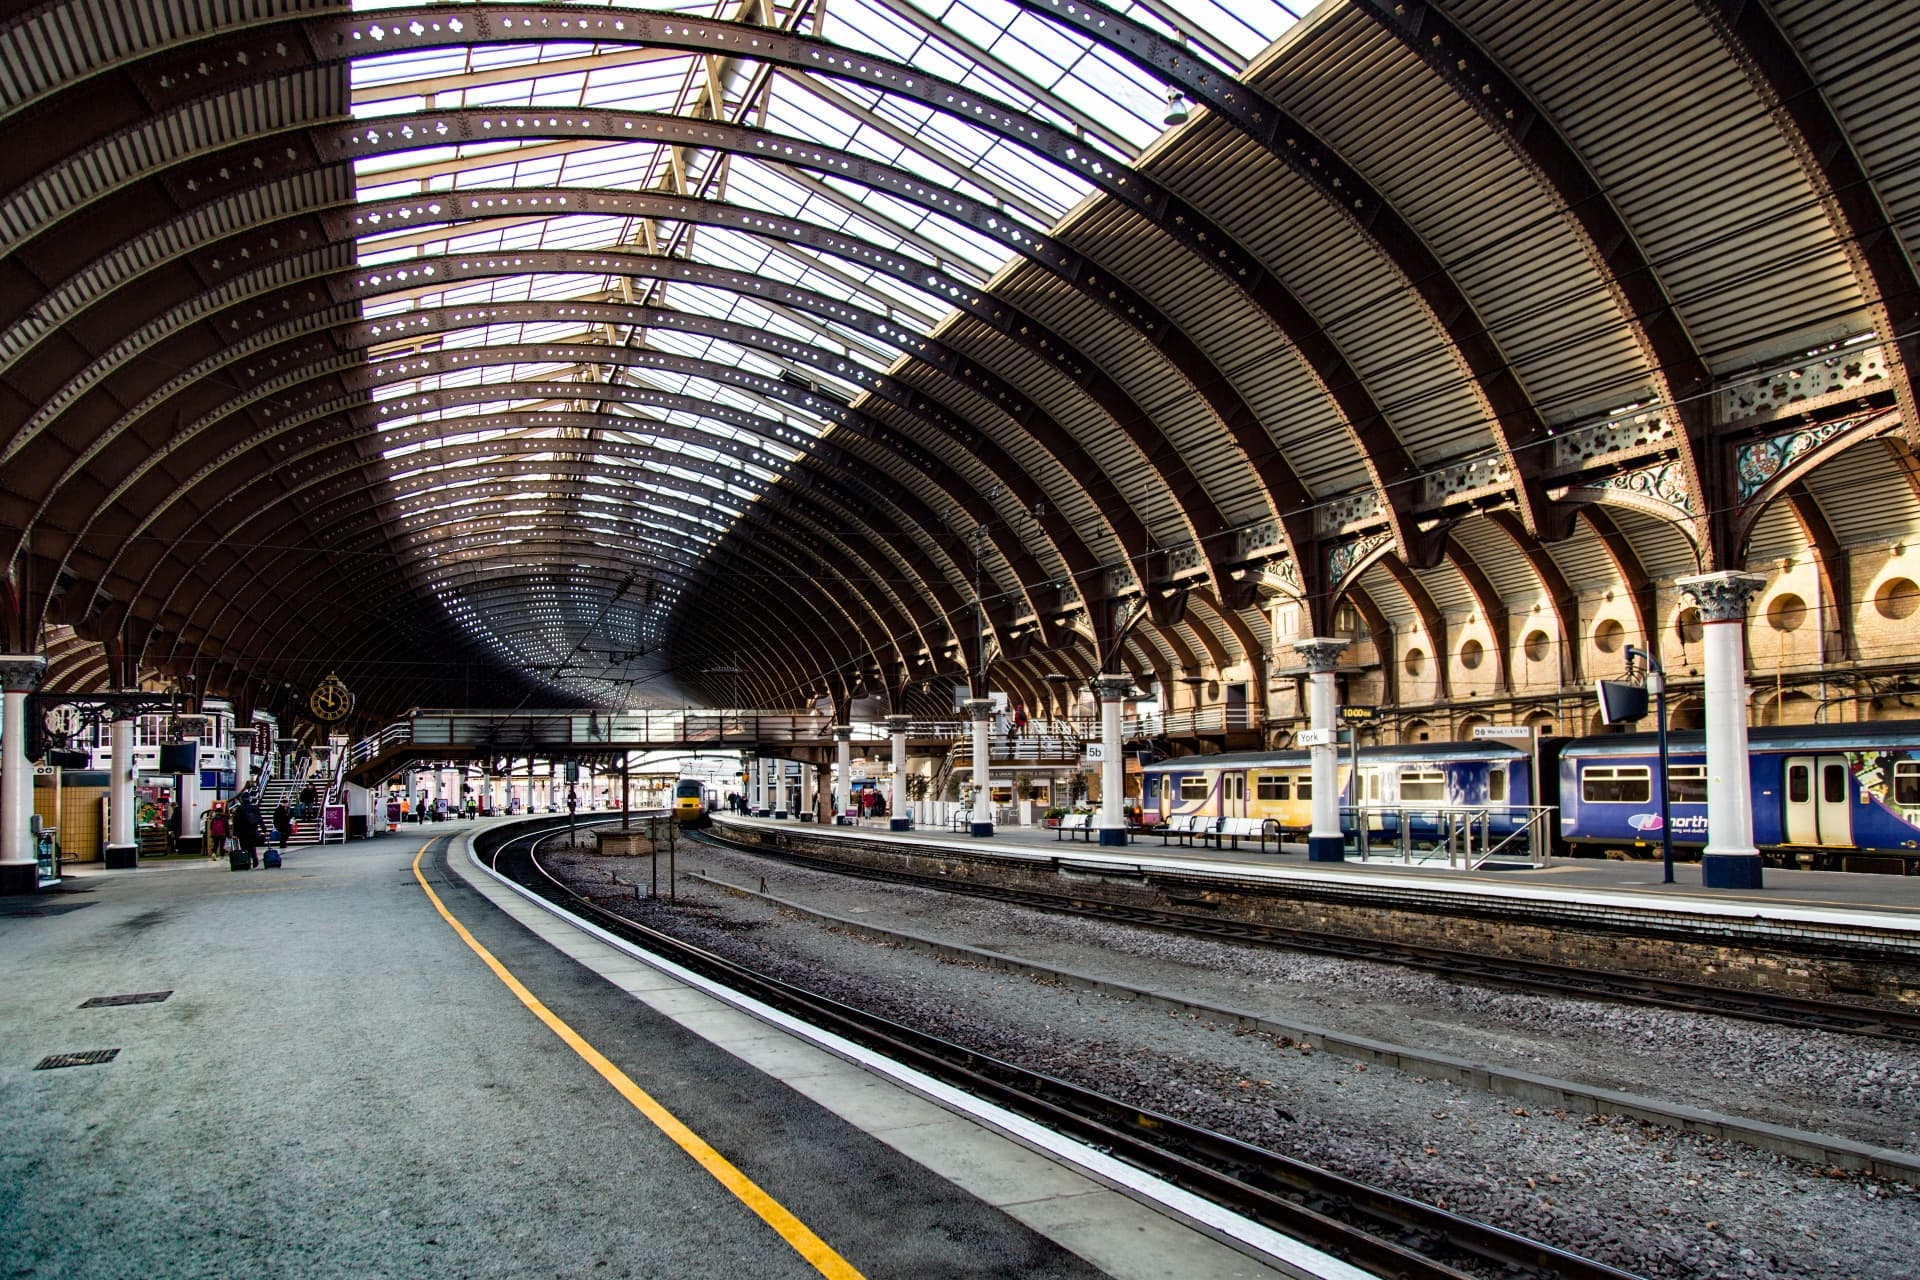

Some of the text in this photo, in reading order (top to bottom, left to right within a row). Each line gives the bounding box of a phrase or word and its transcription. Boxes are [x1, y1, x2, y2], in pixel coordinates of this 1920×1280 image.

[1300, 732, 1319, 742] York
[1089, 747, 1102, 757] 5b
[1670, 816, 1708, 827] north
